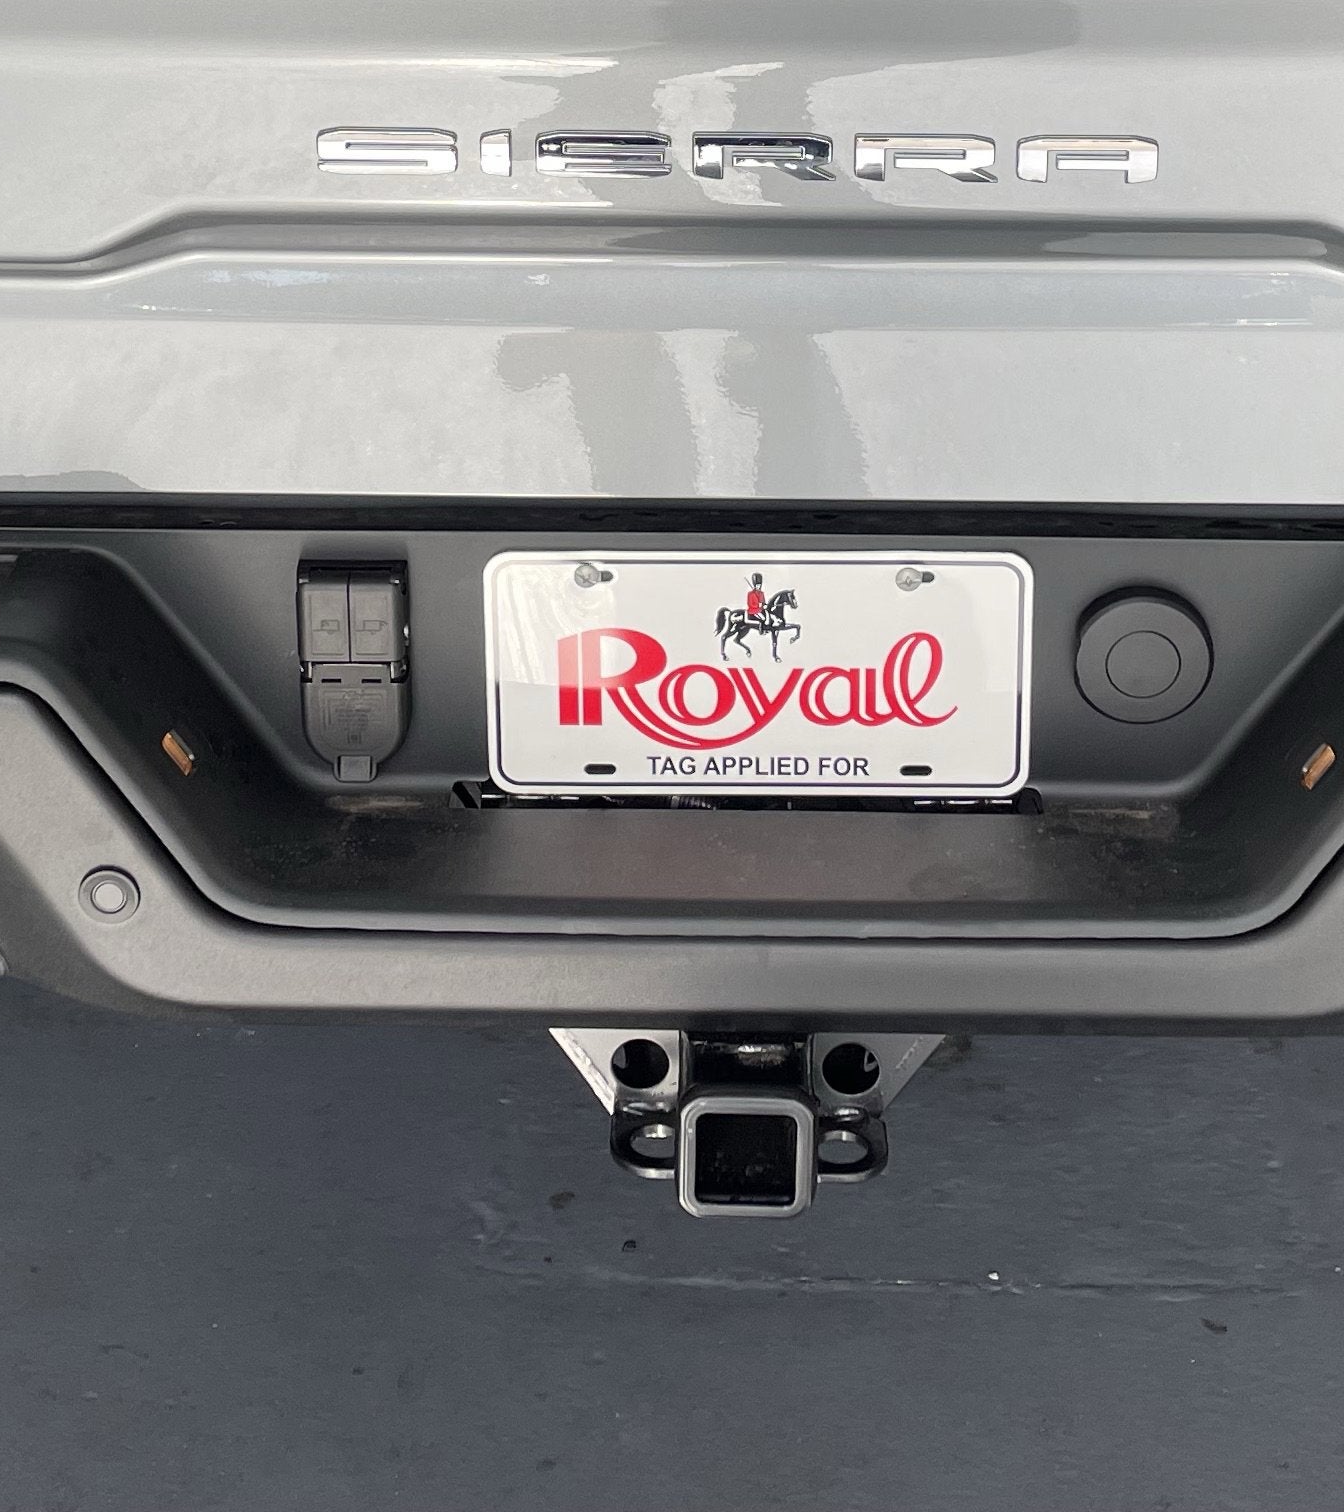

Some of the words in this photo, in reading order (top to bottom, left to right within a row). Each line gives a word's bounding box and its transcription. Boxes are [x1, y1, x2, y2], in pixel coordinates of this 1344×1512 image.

[316, 127, 1160, 184] SIERRA
[557, 628, 958, 750] Royal
[646, 756, 697, 776] TAG
[703, 756, 810, 776] APPLIED
[818, 756, 870, 777] FOR
